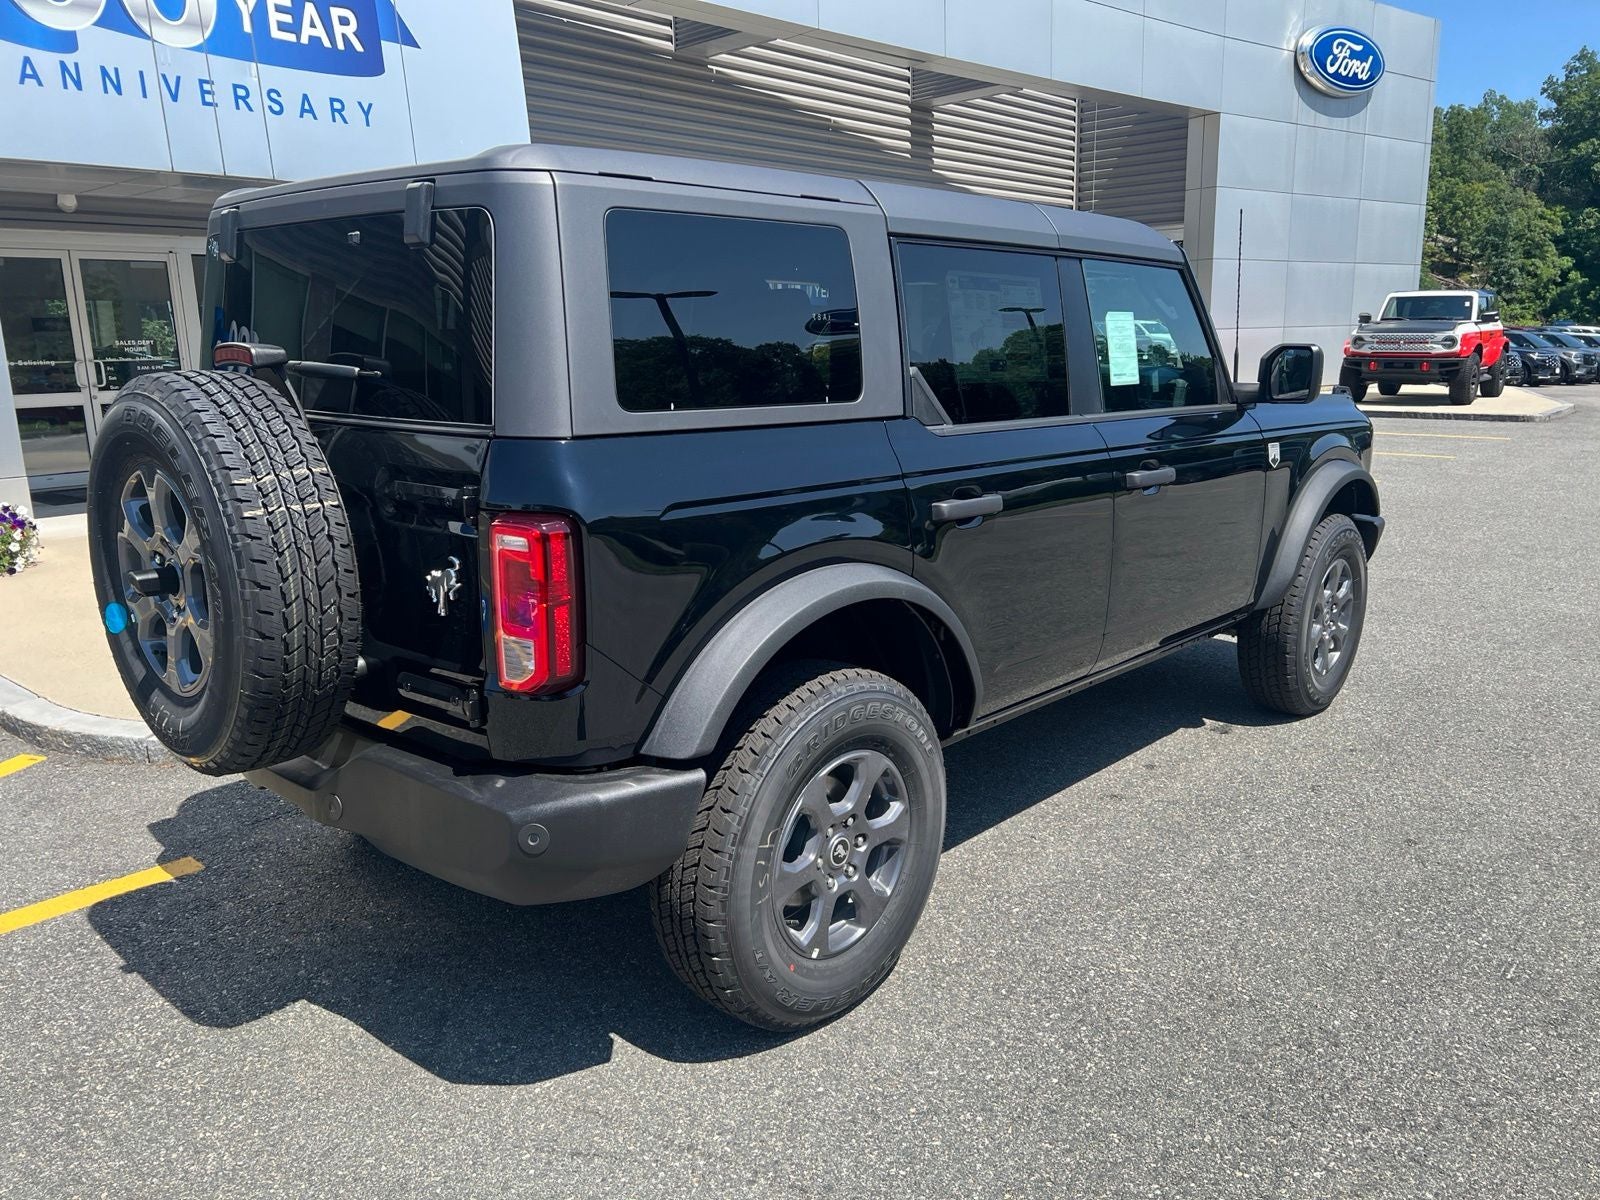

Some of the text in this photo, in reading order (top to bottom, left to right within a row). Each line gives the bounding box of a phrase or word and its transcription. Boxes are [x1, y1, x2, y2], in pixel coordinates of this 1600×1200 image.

[236, 0, 365, 53] YEAR
[1326, 38, 1374, 81] Ford
[18, 55, 374, 128] ANNIVERSARY
[121, 406, 212, 542] DUELER
[785, 701, 936, 780] BRIDGESTONE
